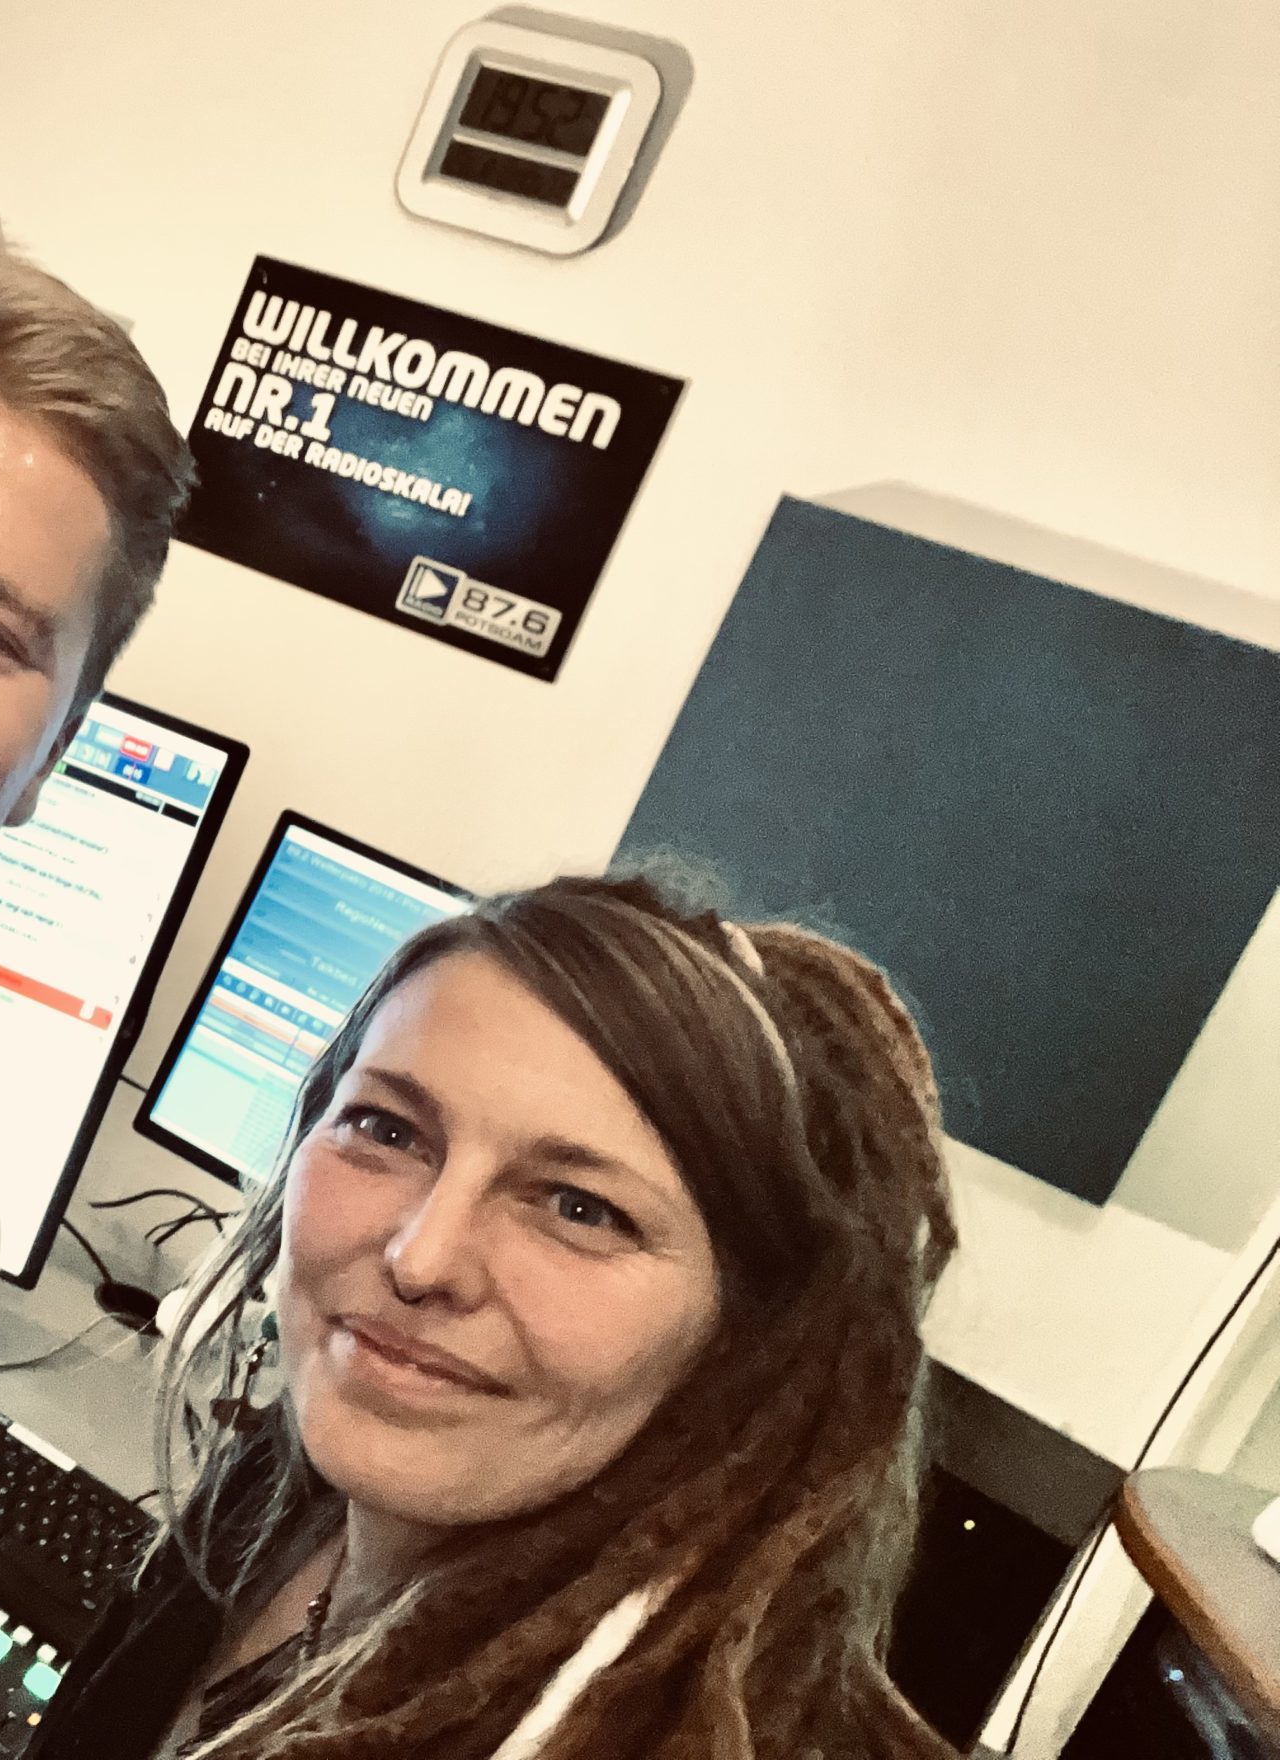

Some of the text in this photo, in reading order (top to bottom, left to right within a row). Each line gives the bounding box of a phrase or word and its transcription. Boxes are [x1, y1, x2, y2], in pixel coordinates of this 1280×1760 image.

[230, 336, 434, 422] BEI IHRER NEUEN
[242, 290, 623, 450] WILLKOMMEN
[203, 407, 473, 517] AUF DER RADIOSKALA!
[454, 610, 543, 651] POTSDAM
[462, 587, 551, 635] 87.6
